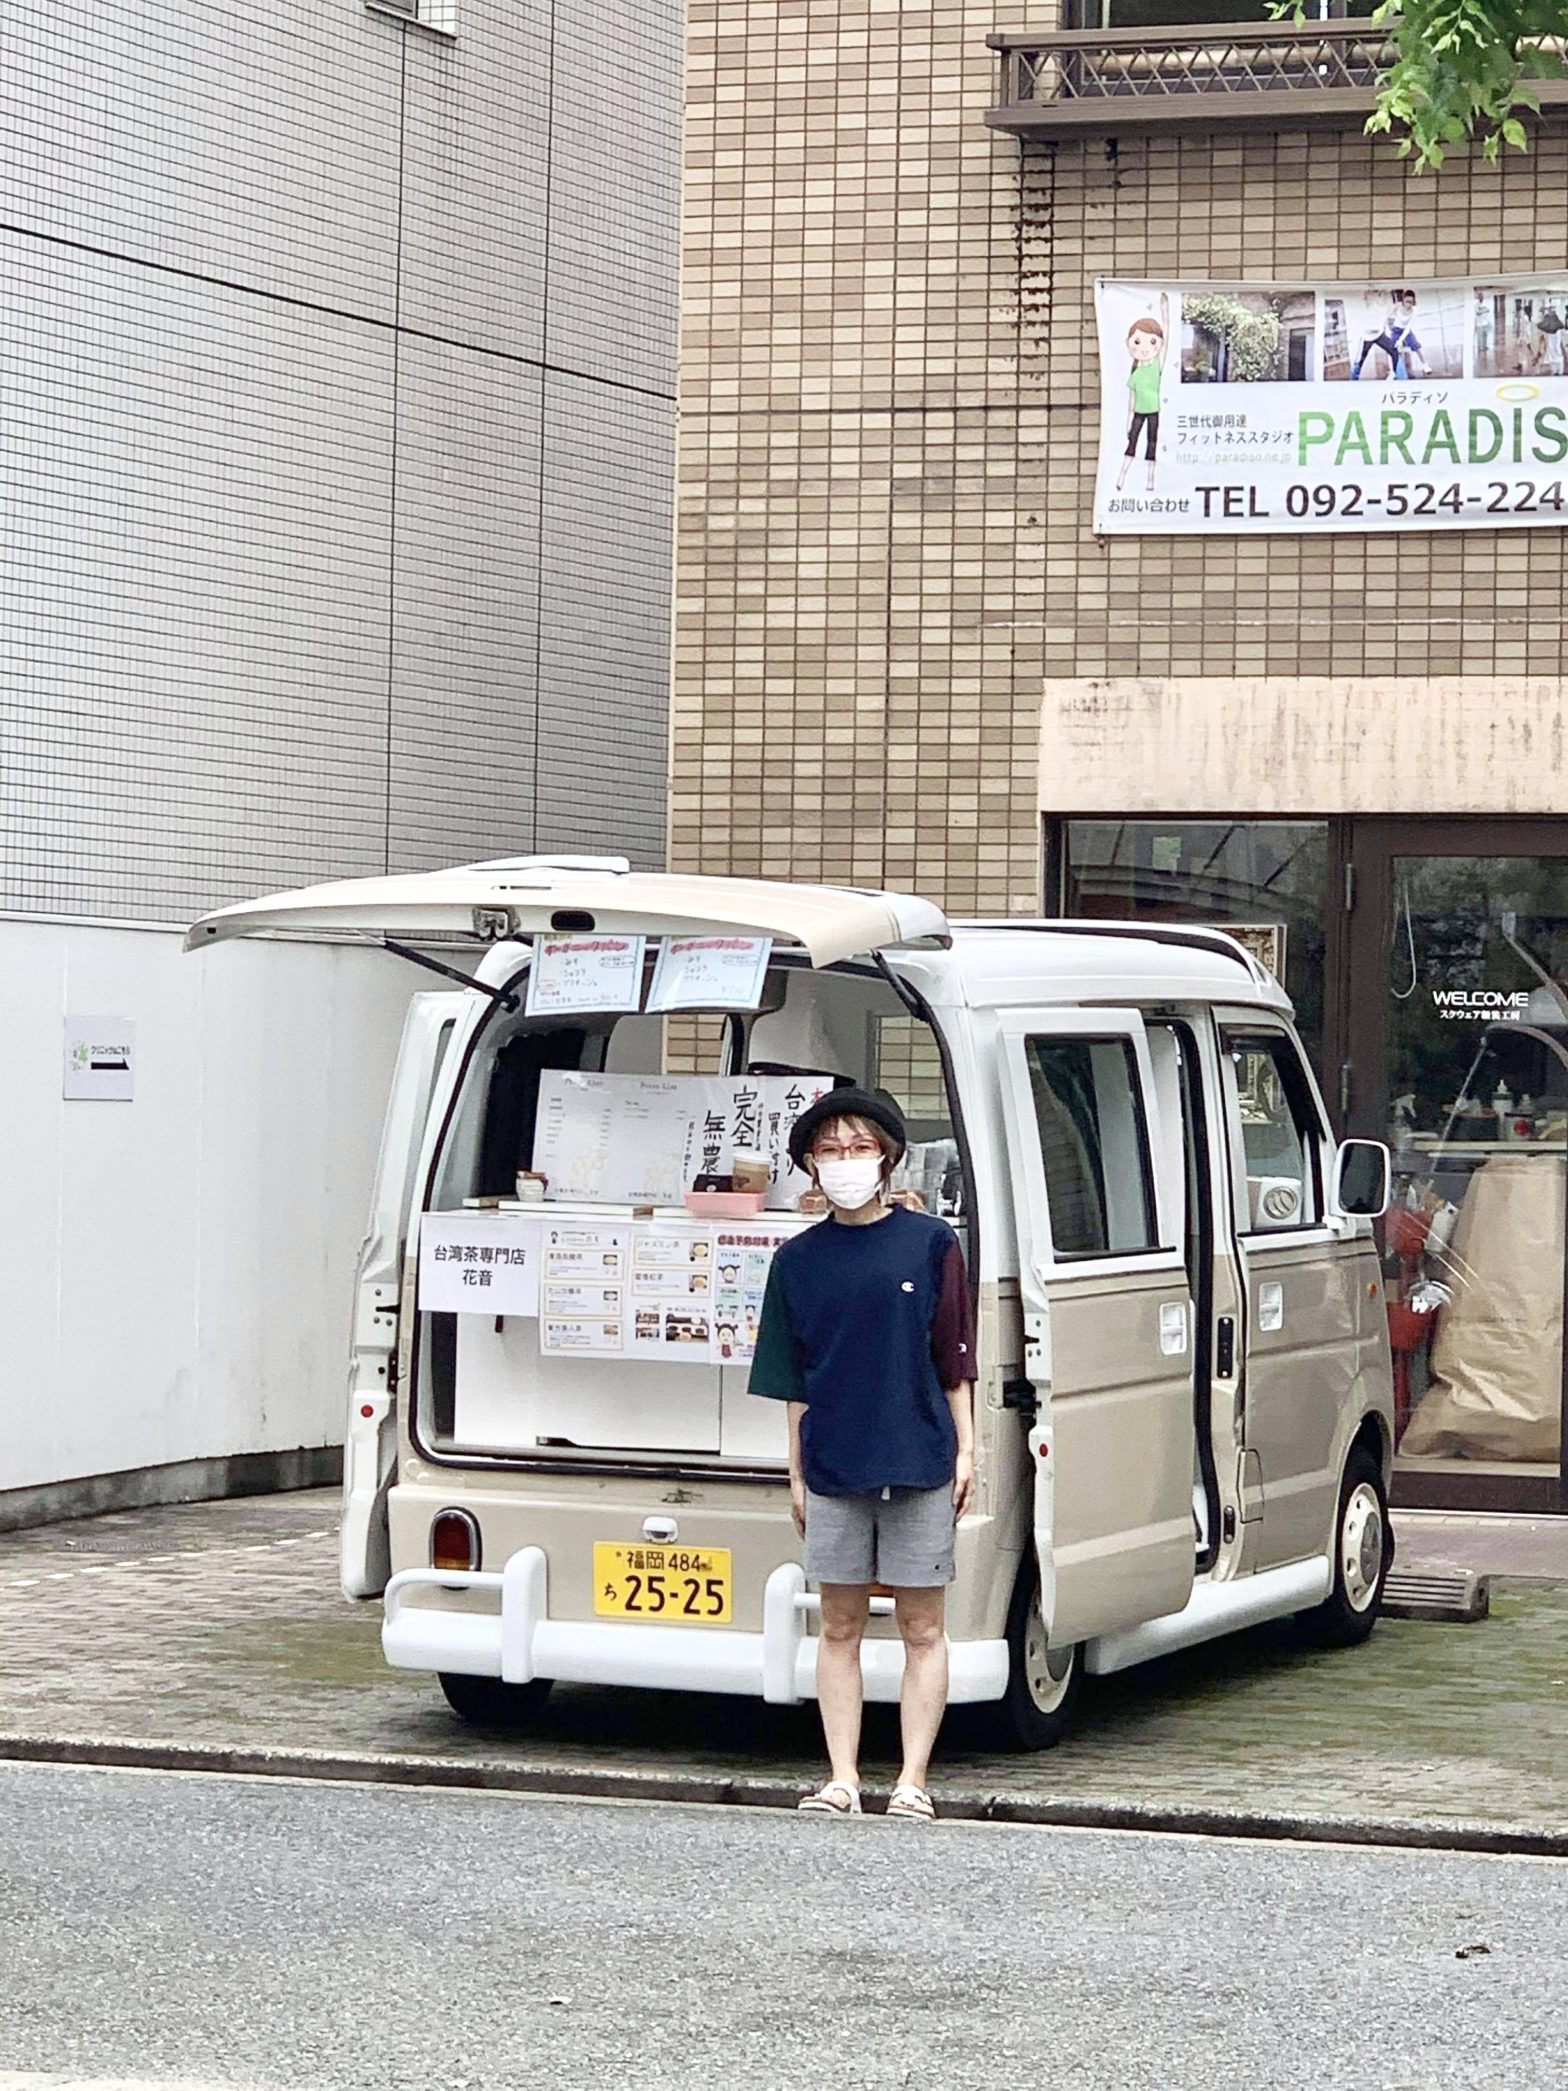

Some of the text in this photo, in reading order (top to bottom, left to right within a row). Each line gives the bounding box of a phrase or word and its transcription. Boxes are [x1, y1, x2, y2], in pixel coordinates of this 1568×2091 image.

[1176, 414, 1247, 429] 三世代御用達
[1176, 430, 1294, 445] フィットネススタジオ
[1298, 406, 1567, 466] PARADIS
[1108, 481, 1565, 518] お問い合わせ TEL 092-524-224
[1433, 991, 1529, 1007] WELCOME
[730, 1084, 759, 1148] 完全
[434, 1244, 526, 1266] 台湾茶専門店
[462, 1268, 493, 1287] 花音
[627, 1550, 700, 1572] 福岡 484
[625, 1575, 724, 1616] 25-25
